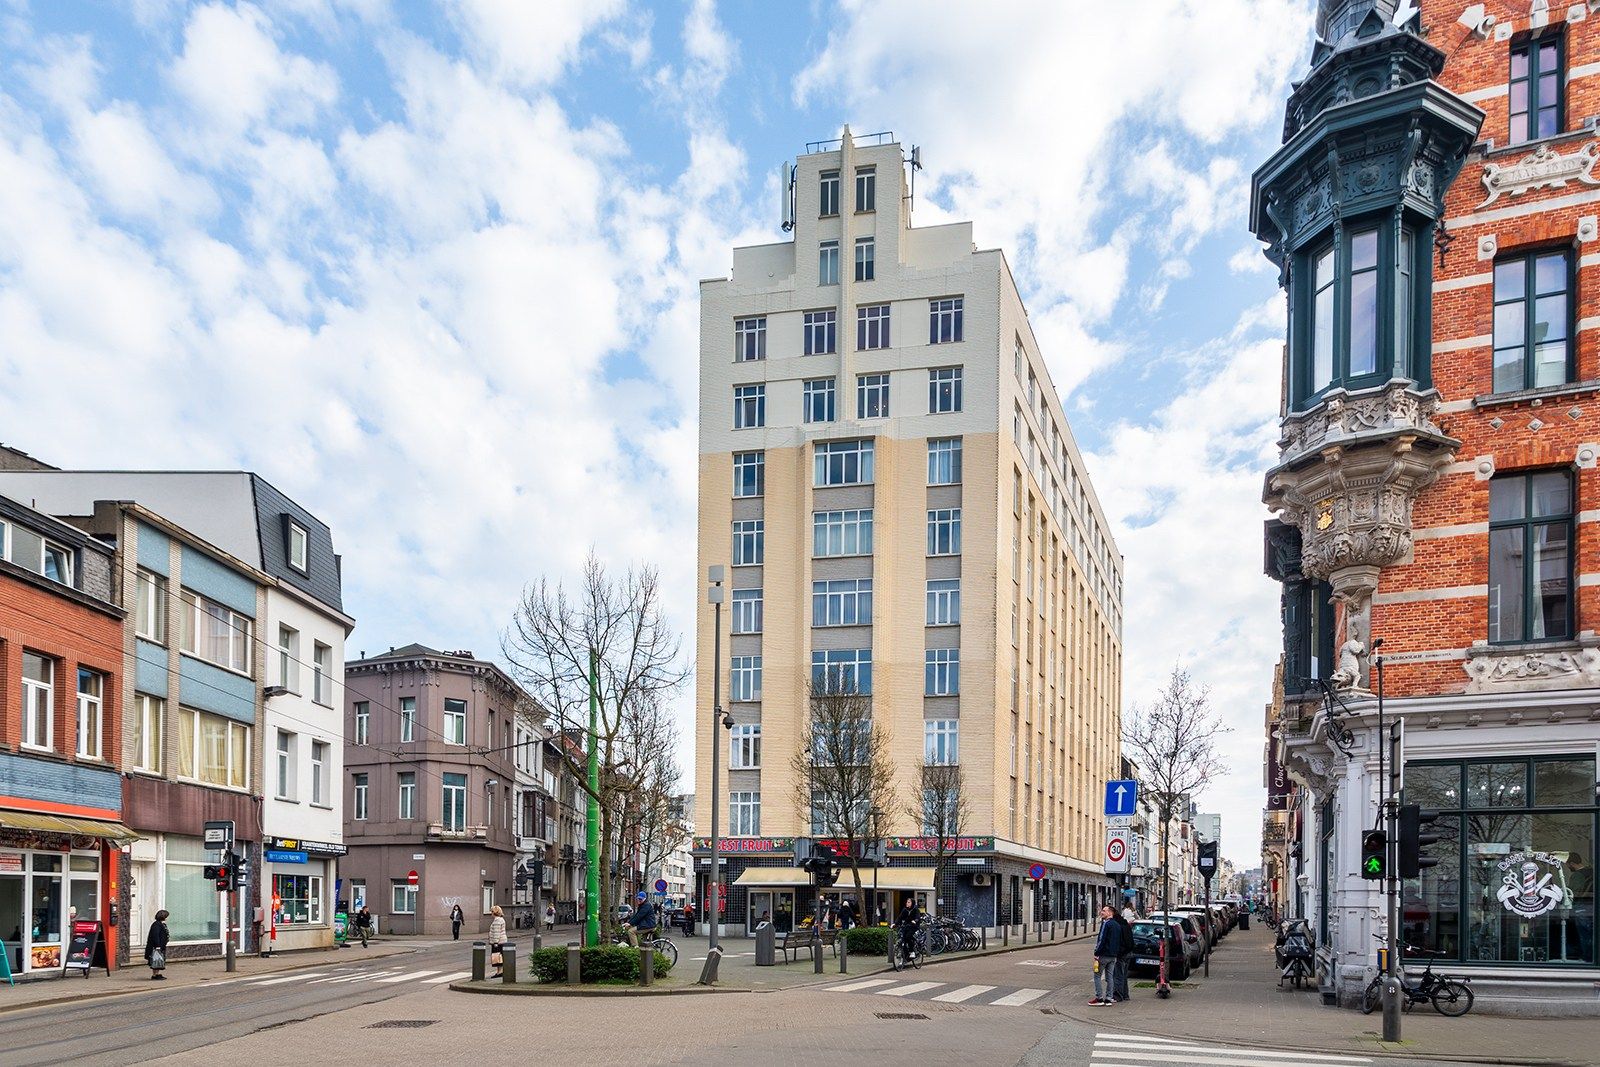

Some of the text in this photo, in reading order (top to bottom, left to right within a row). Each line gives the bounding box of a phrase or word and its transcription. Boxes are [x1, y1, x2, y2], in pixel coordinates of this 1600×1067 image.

[741, 839, 773, 851] FRUIT
[910, 838, 938, 850] BEST
[1111, 845, 1122, 855] 30
